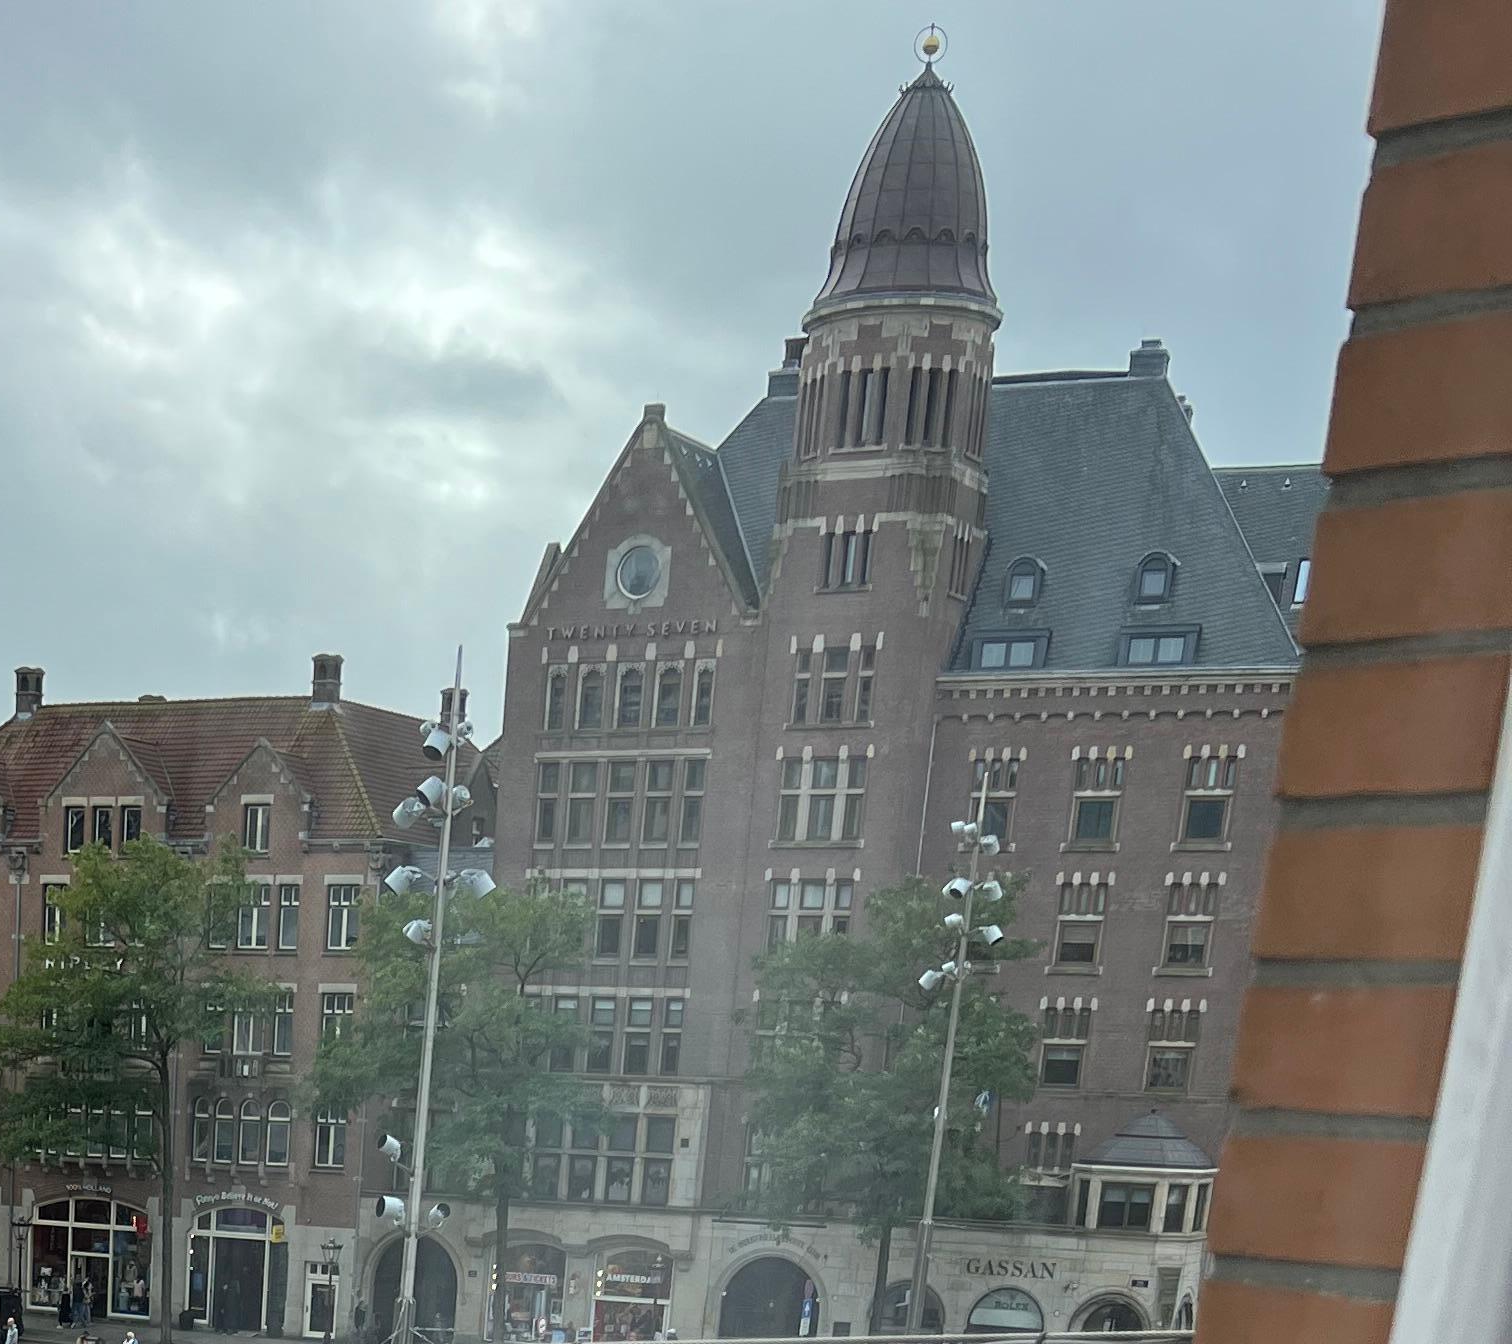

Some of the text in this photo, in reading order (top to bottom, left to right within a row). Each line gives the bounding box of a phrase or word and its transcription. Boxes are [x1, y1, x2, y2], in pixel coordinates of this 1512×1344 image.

[547, 619, 719, 641] TWENTY SEVEN
[45, 956, 124, 970] RIPLY
[966, 1258, 1057, 1279] GASSAN
[994, 1301, 1029, 1311] ROLEX
